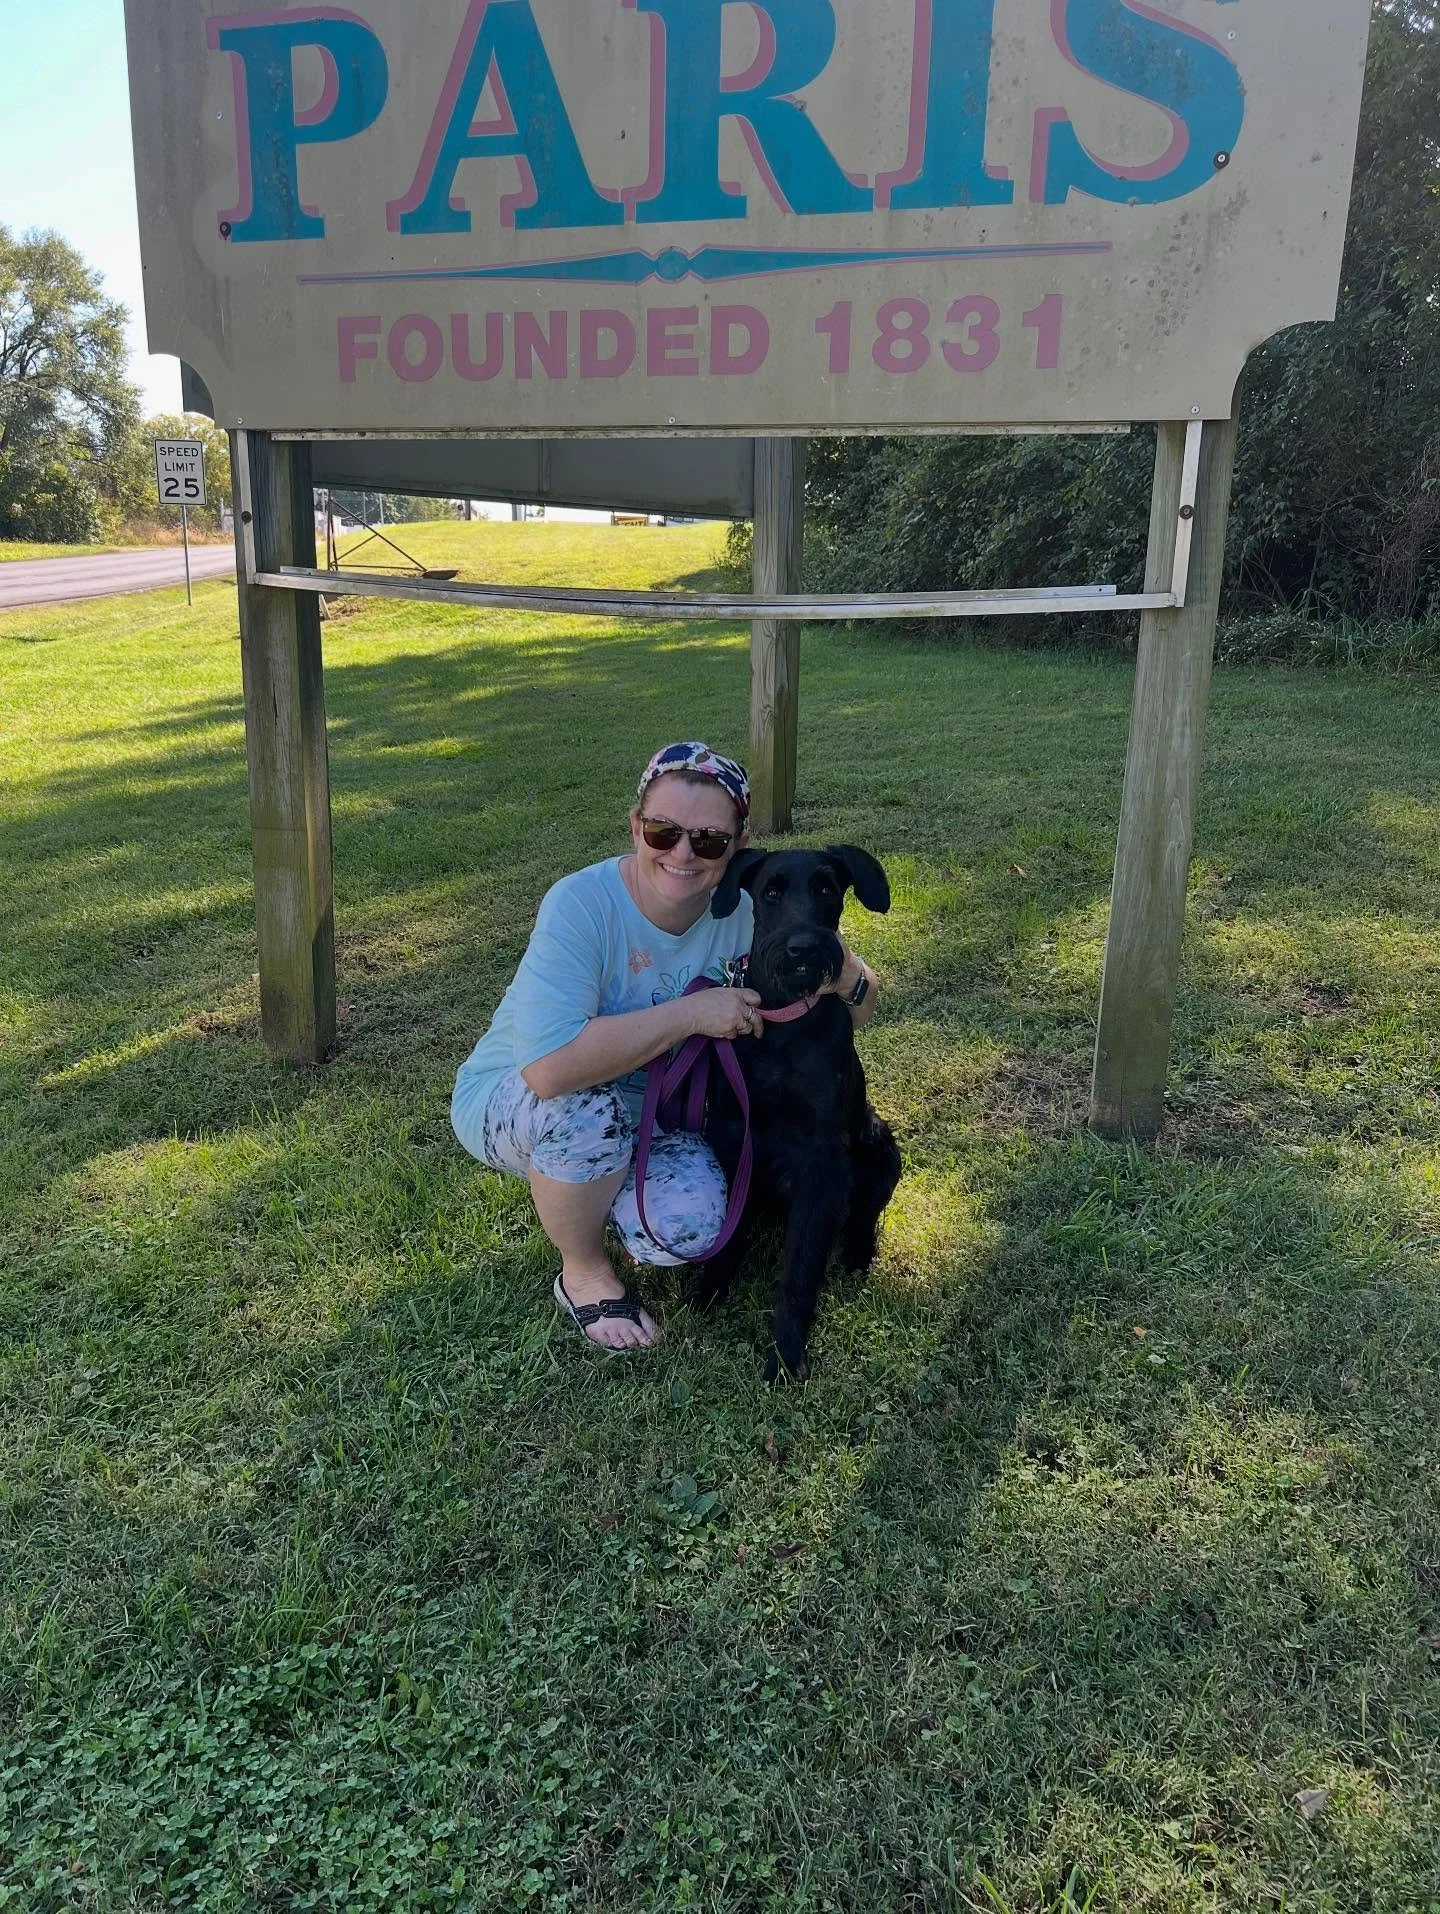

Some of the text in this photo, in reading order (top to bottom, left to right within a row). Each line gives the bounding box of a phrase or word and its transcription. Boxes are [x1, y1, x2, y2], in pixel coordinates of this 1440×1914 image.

[206, 0, 1245, 243] PARIS
[336, 293, 1064, 382] FOUNDED 1831
[159, 446, 199, 457] SPEED
[164, 462, 195, 472] LIMIT
[163, 477, 199, 498] 25
